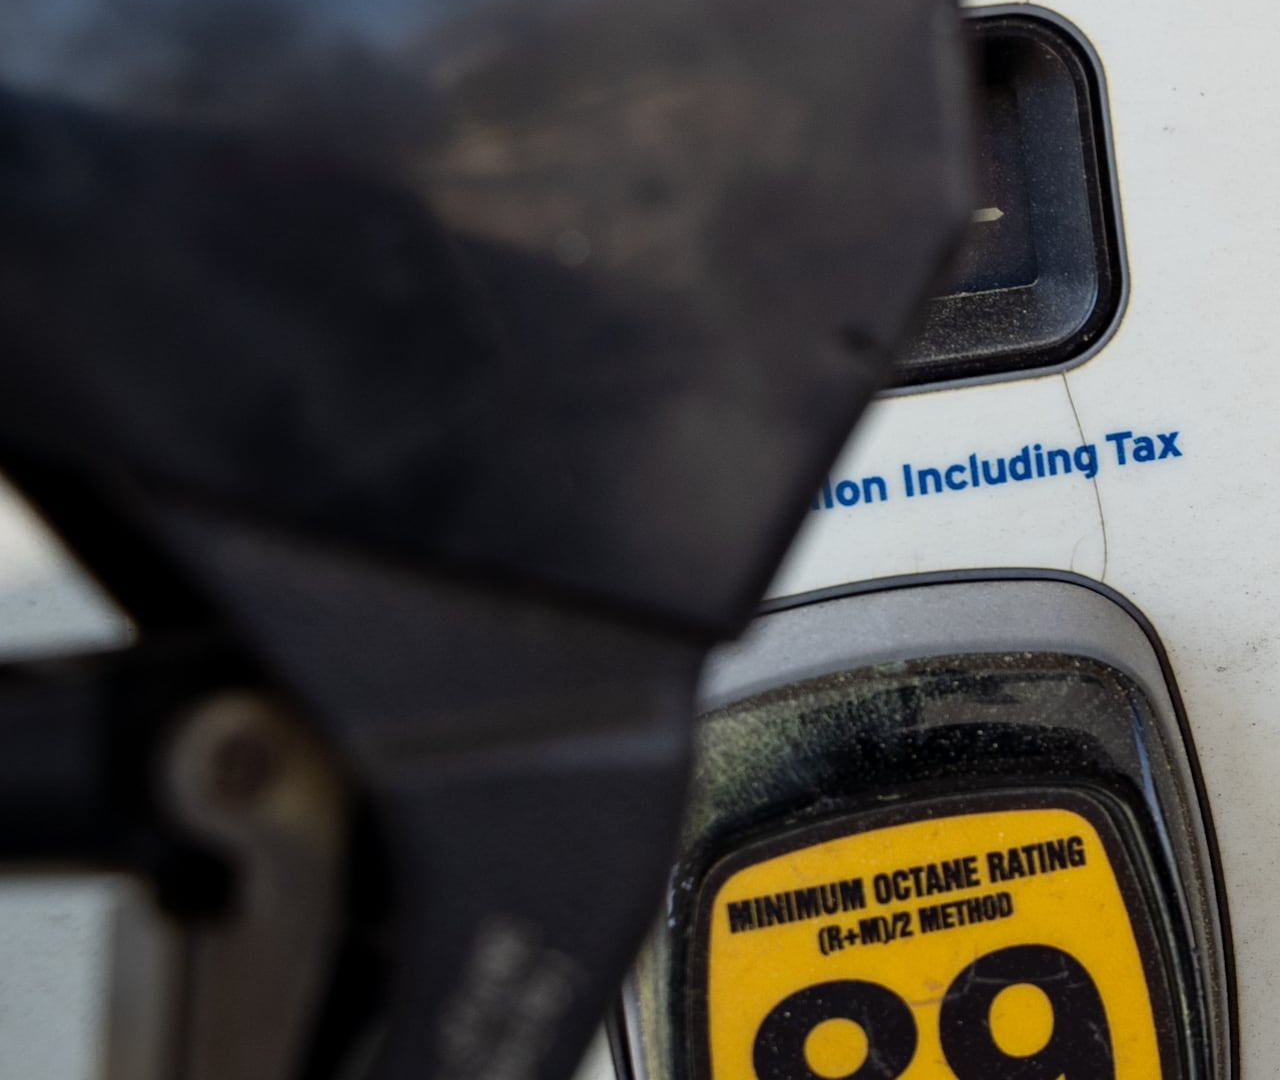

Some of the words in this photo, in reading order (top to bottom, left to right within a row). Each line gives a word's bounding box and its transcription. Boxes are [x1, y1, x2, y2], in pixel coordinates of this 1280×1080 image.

[810, 474, 888, 510] lon
[902, 443, 1098, 497] Including
[1105, 430, 1183, 466] Tax
[727, 876, 867, 933] MINIMUM
[874, 857, 981, 905] OCTANE
[987, 836, 1086, 883] RATING
[818, 920, 914, 956] (R+M)/2
[919, 892, 1014, 937] METHOD
